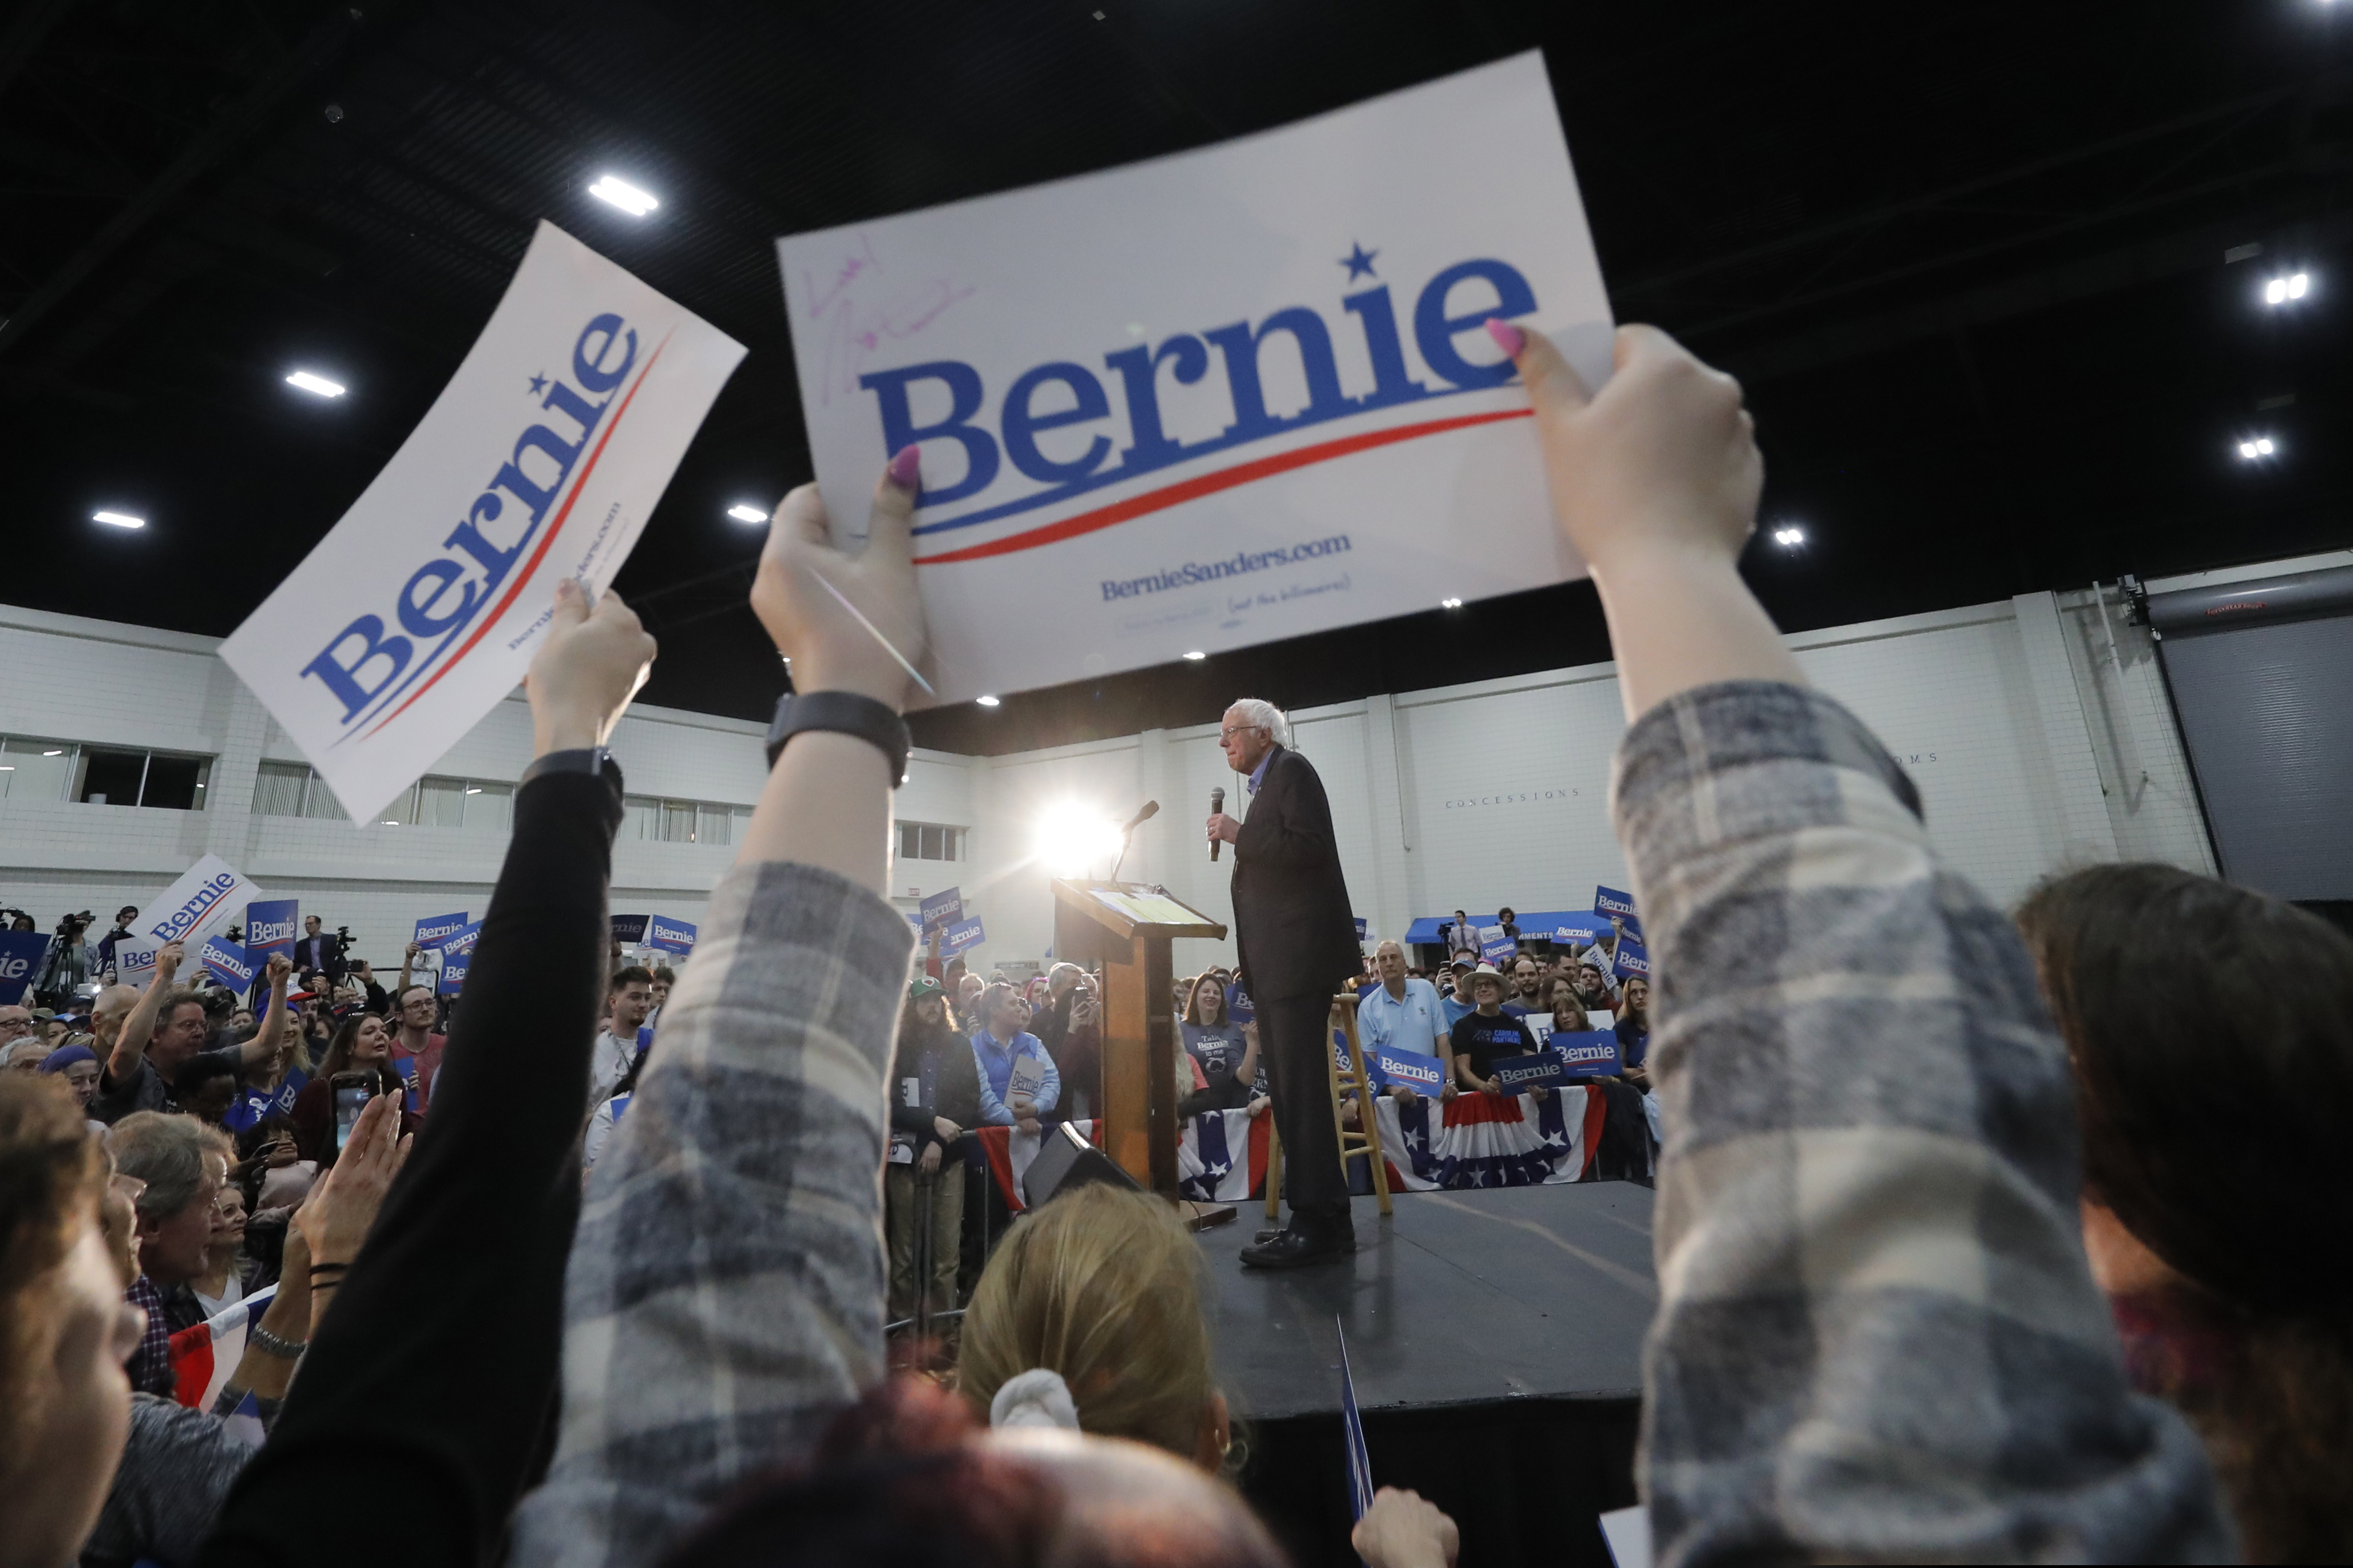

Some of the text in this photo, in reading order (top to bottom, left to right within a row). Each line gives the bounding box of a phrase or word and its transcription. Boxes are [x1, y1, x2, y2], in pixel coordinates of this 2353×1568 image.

[858, 240, 1539, 510] Bernie
[299, 312, 638, 725] Bernie
[1100, 534, 1353, 602] BernieSanders.com
[1445, 788, 1579, 808] CONCESSIONS
[150, 873, 235, 942] Bernie
[923, 899, 960, 922] Bernie
[251, 917, 295, 942] Bernie
[443, 928, 480, 955] Bern
[654, 924, 694, 944] Bernie
[950, 926, 981, 943] ernie
[1556, 927, 1593, 938] Bernie
[1621, 926, 1642, 943] Bernie
[201, 943, 252, 980] Bernie
[1484, 943, 1515, 956] Bernie
[1589, 950, 1614, 985] Bernie
[1554, 1043, 1615, 1061] Bernie
[1011, 1070, 1039, 1094] Bernie
[1380, 1057, 1440, 1083] Bernie
[1499, 1062, 1561, 1083] Bernie
